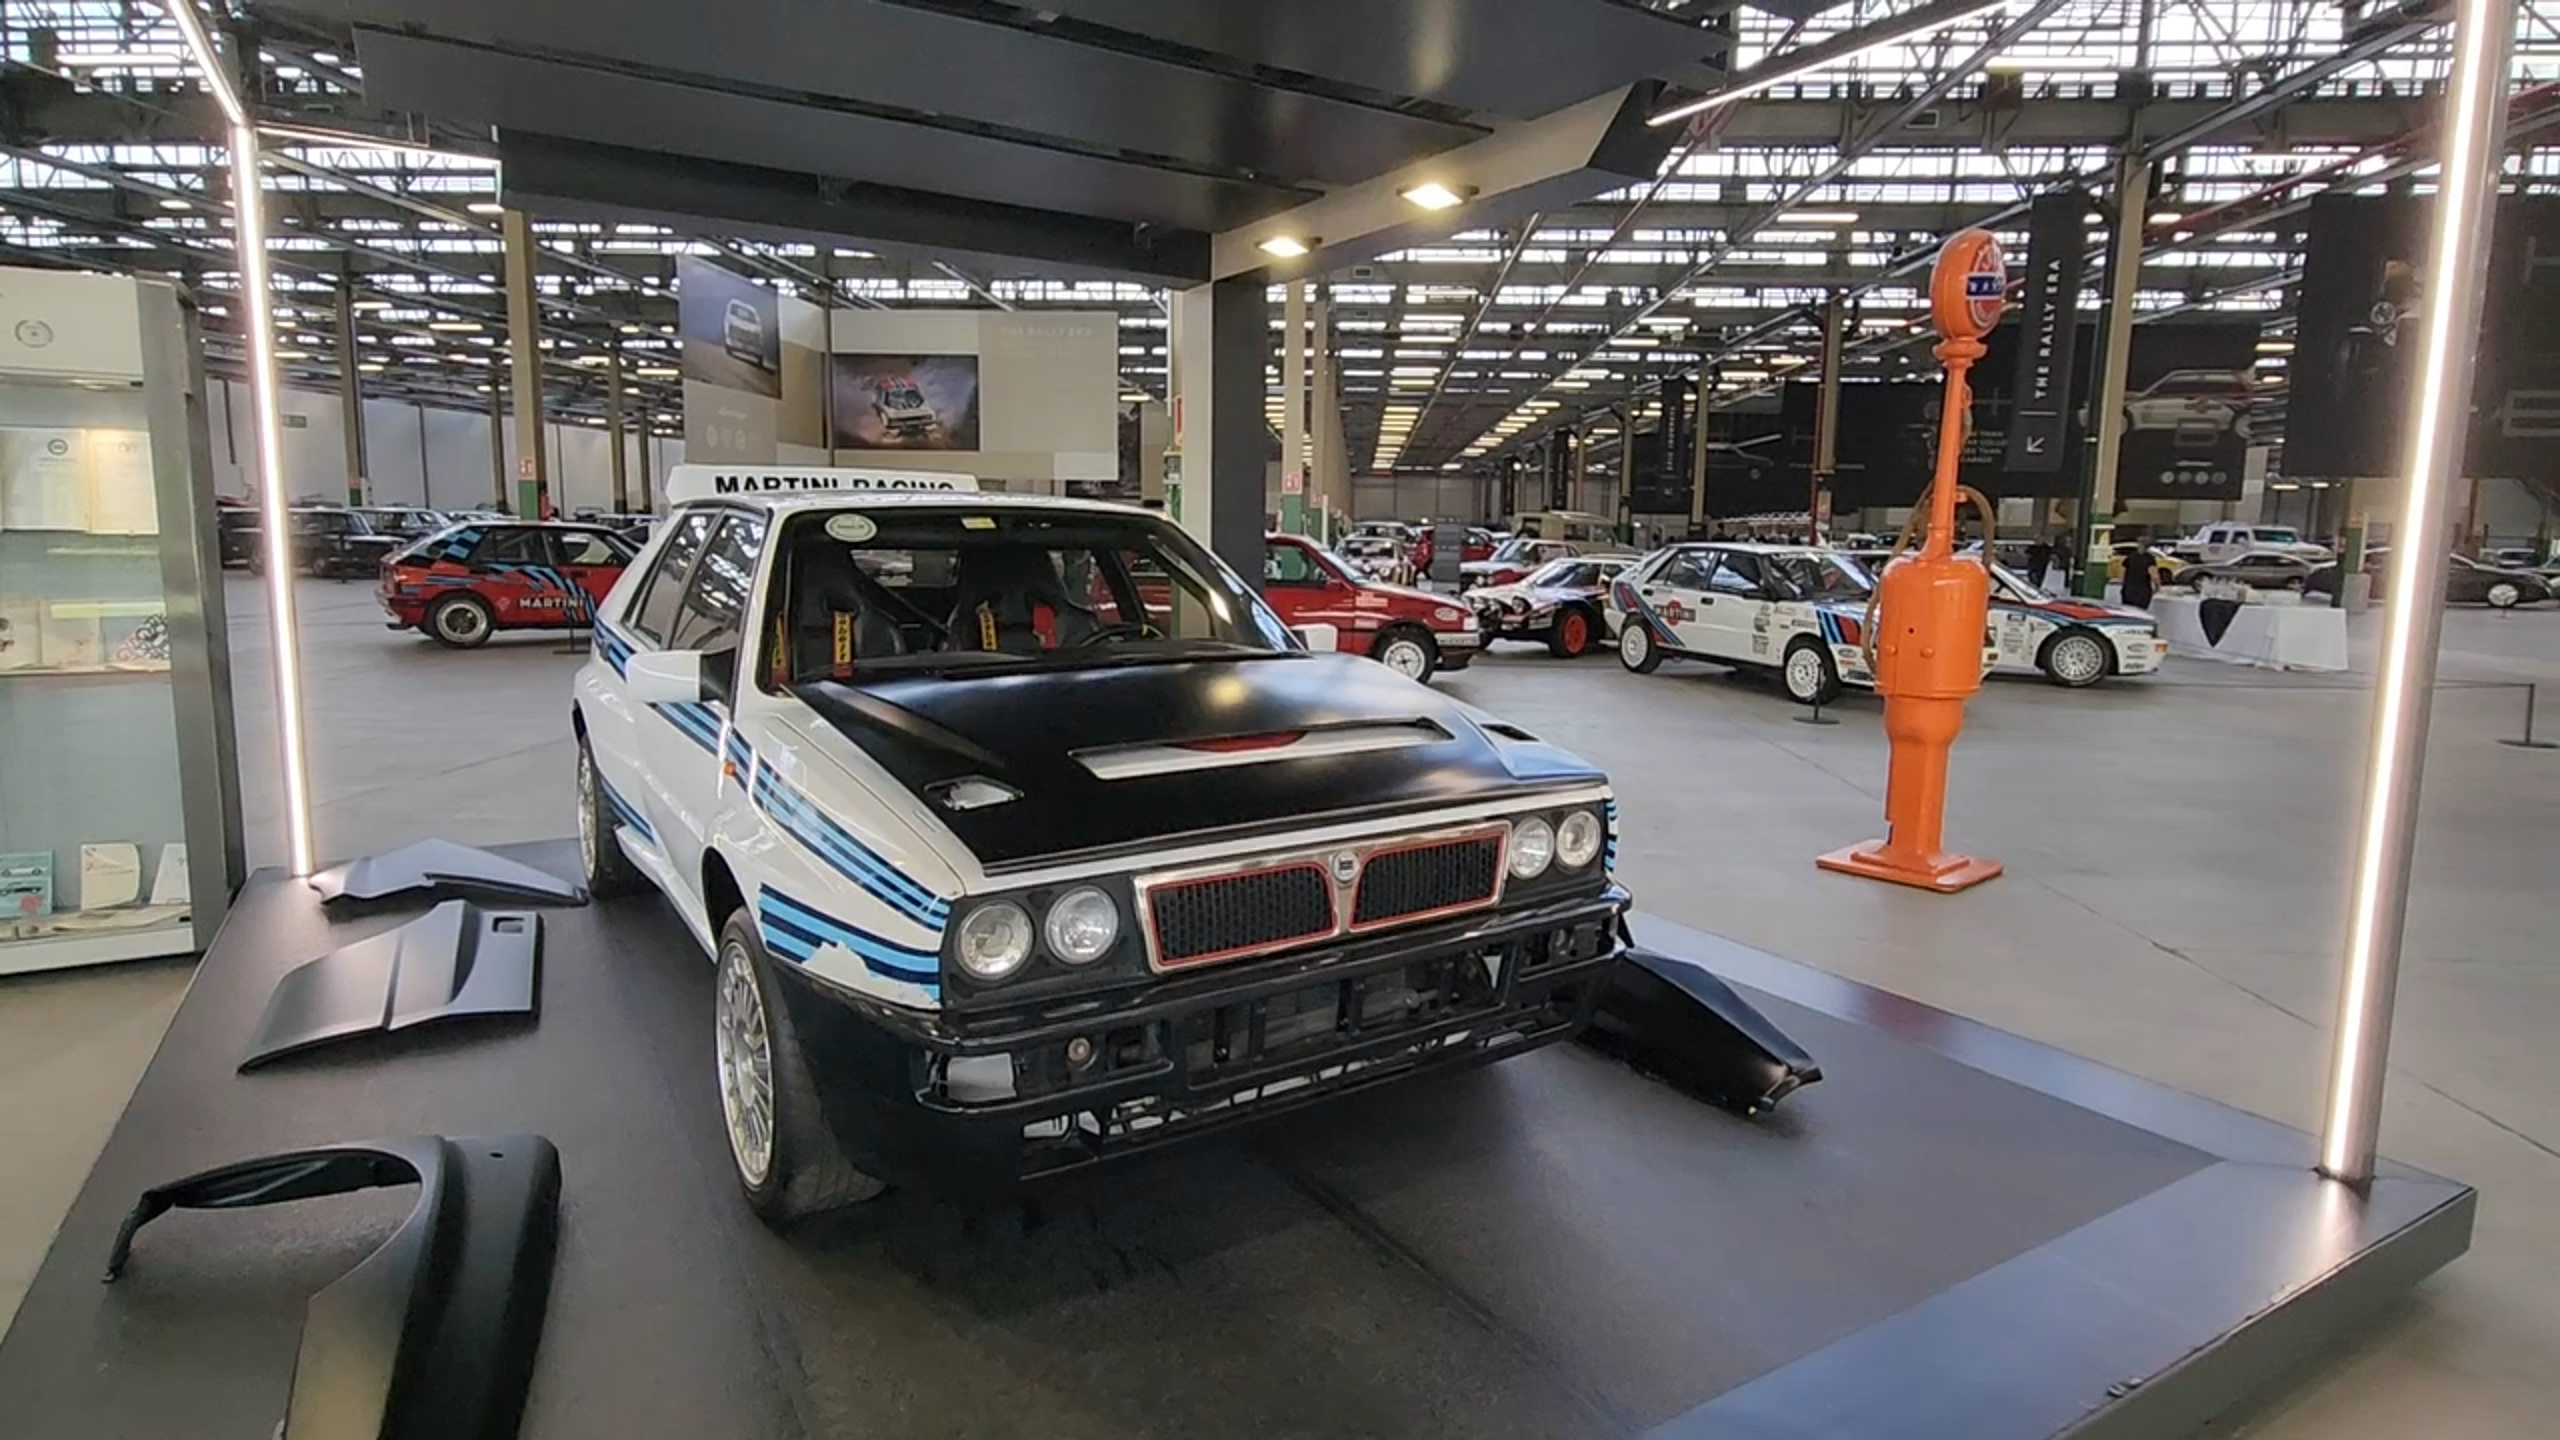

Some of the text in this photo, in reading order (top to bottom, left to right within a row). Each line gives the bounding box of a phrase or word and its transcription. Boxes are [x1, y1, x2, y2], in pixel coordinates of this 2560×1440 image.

[2035, 259, 2061, 399] THE RALLY ERA
[715, 475, 839, 494] MARTINI
[520, 597, 584, 609] MARTINI
